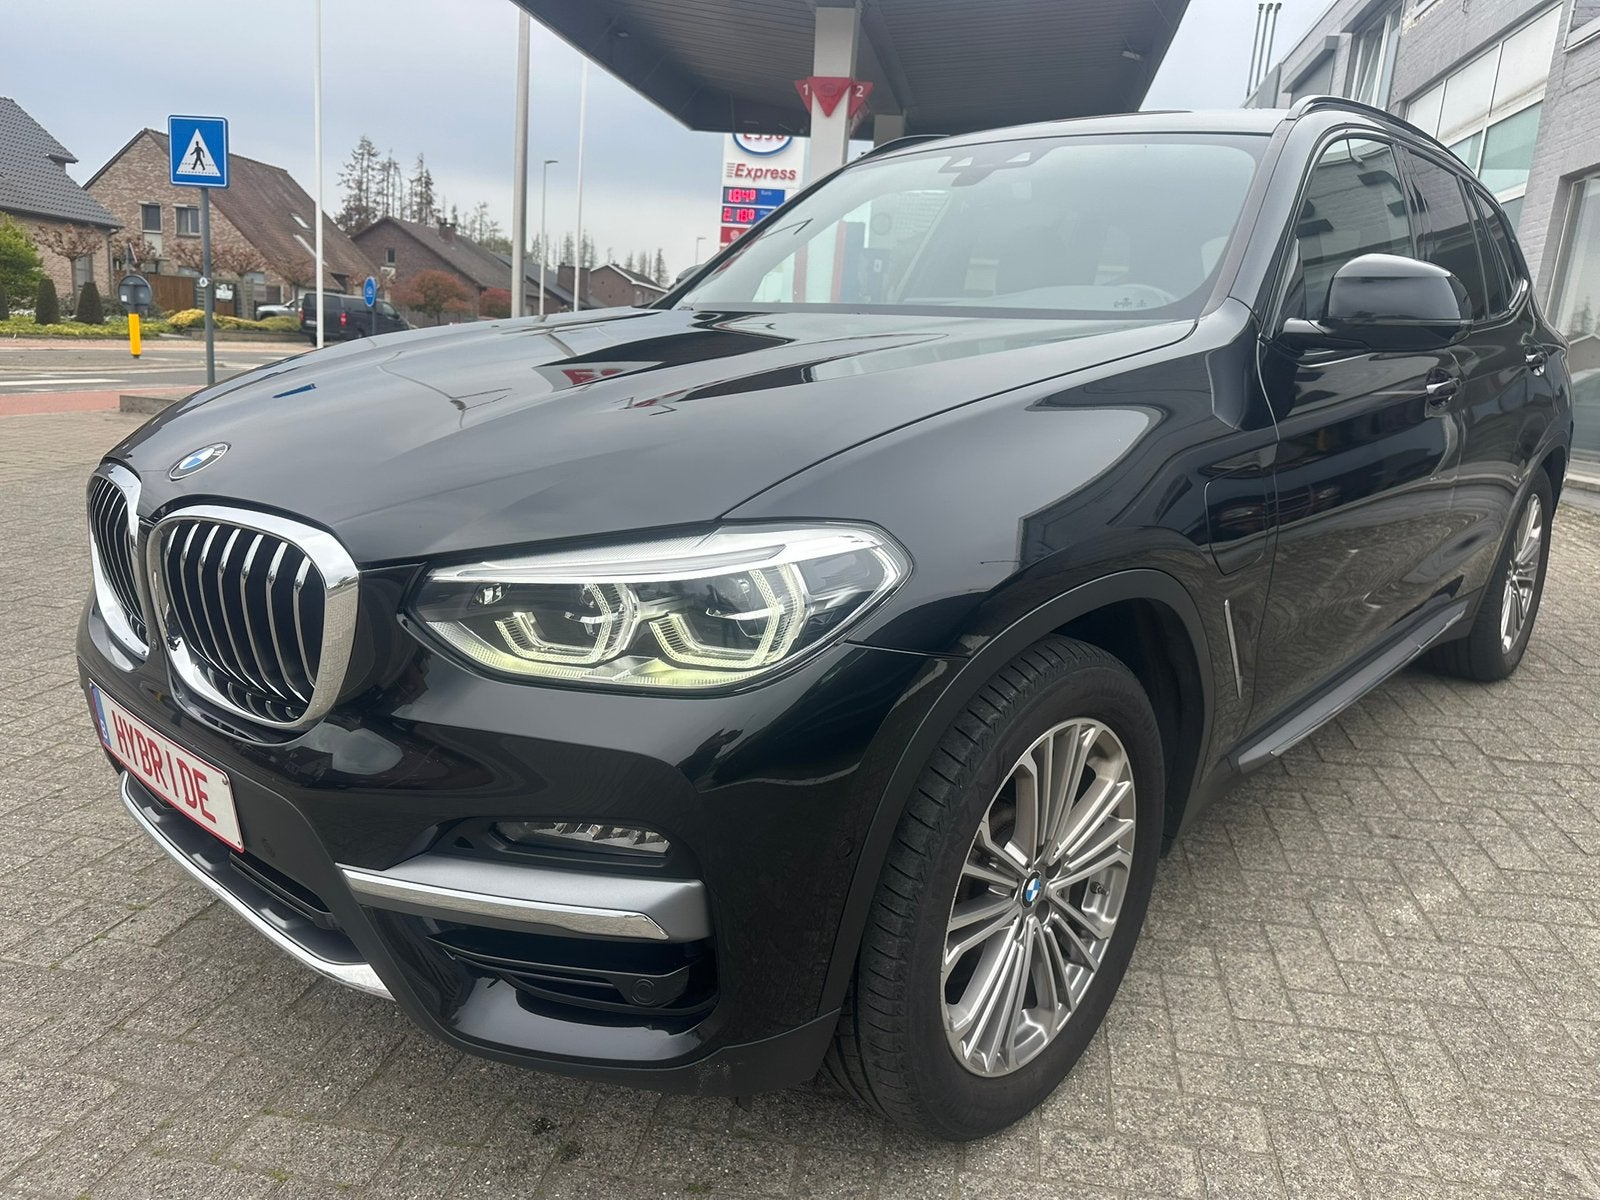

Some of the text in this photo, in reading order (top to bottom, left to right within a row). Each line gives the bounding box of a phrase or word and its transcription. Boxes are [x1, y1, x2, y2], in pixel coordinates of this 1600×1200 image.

[802, 83, 809, 96] 1
[855, 85, 864, 97] 2
[734, 163, 797, 182] Express
[111, 709, 217, 824] HYBRIDE
